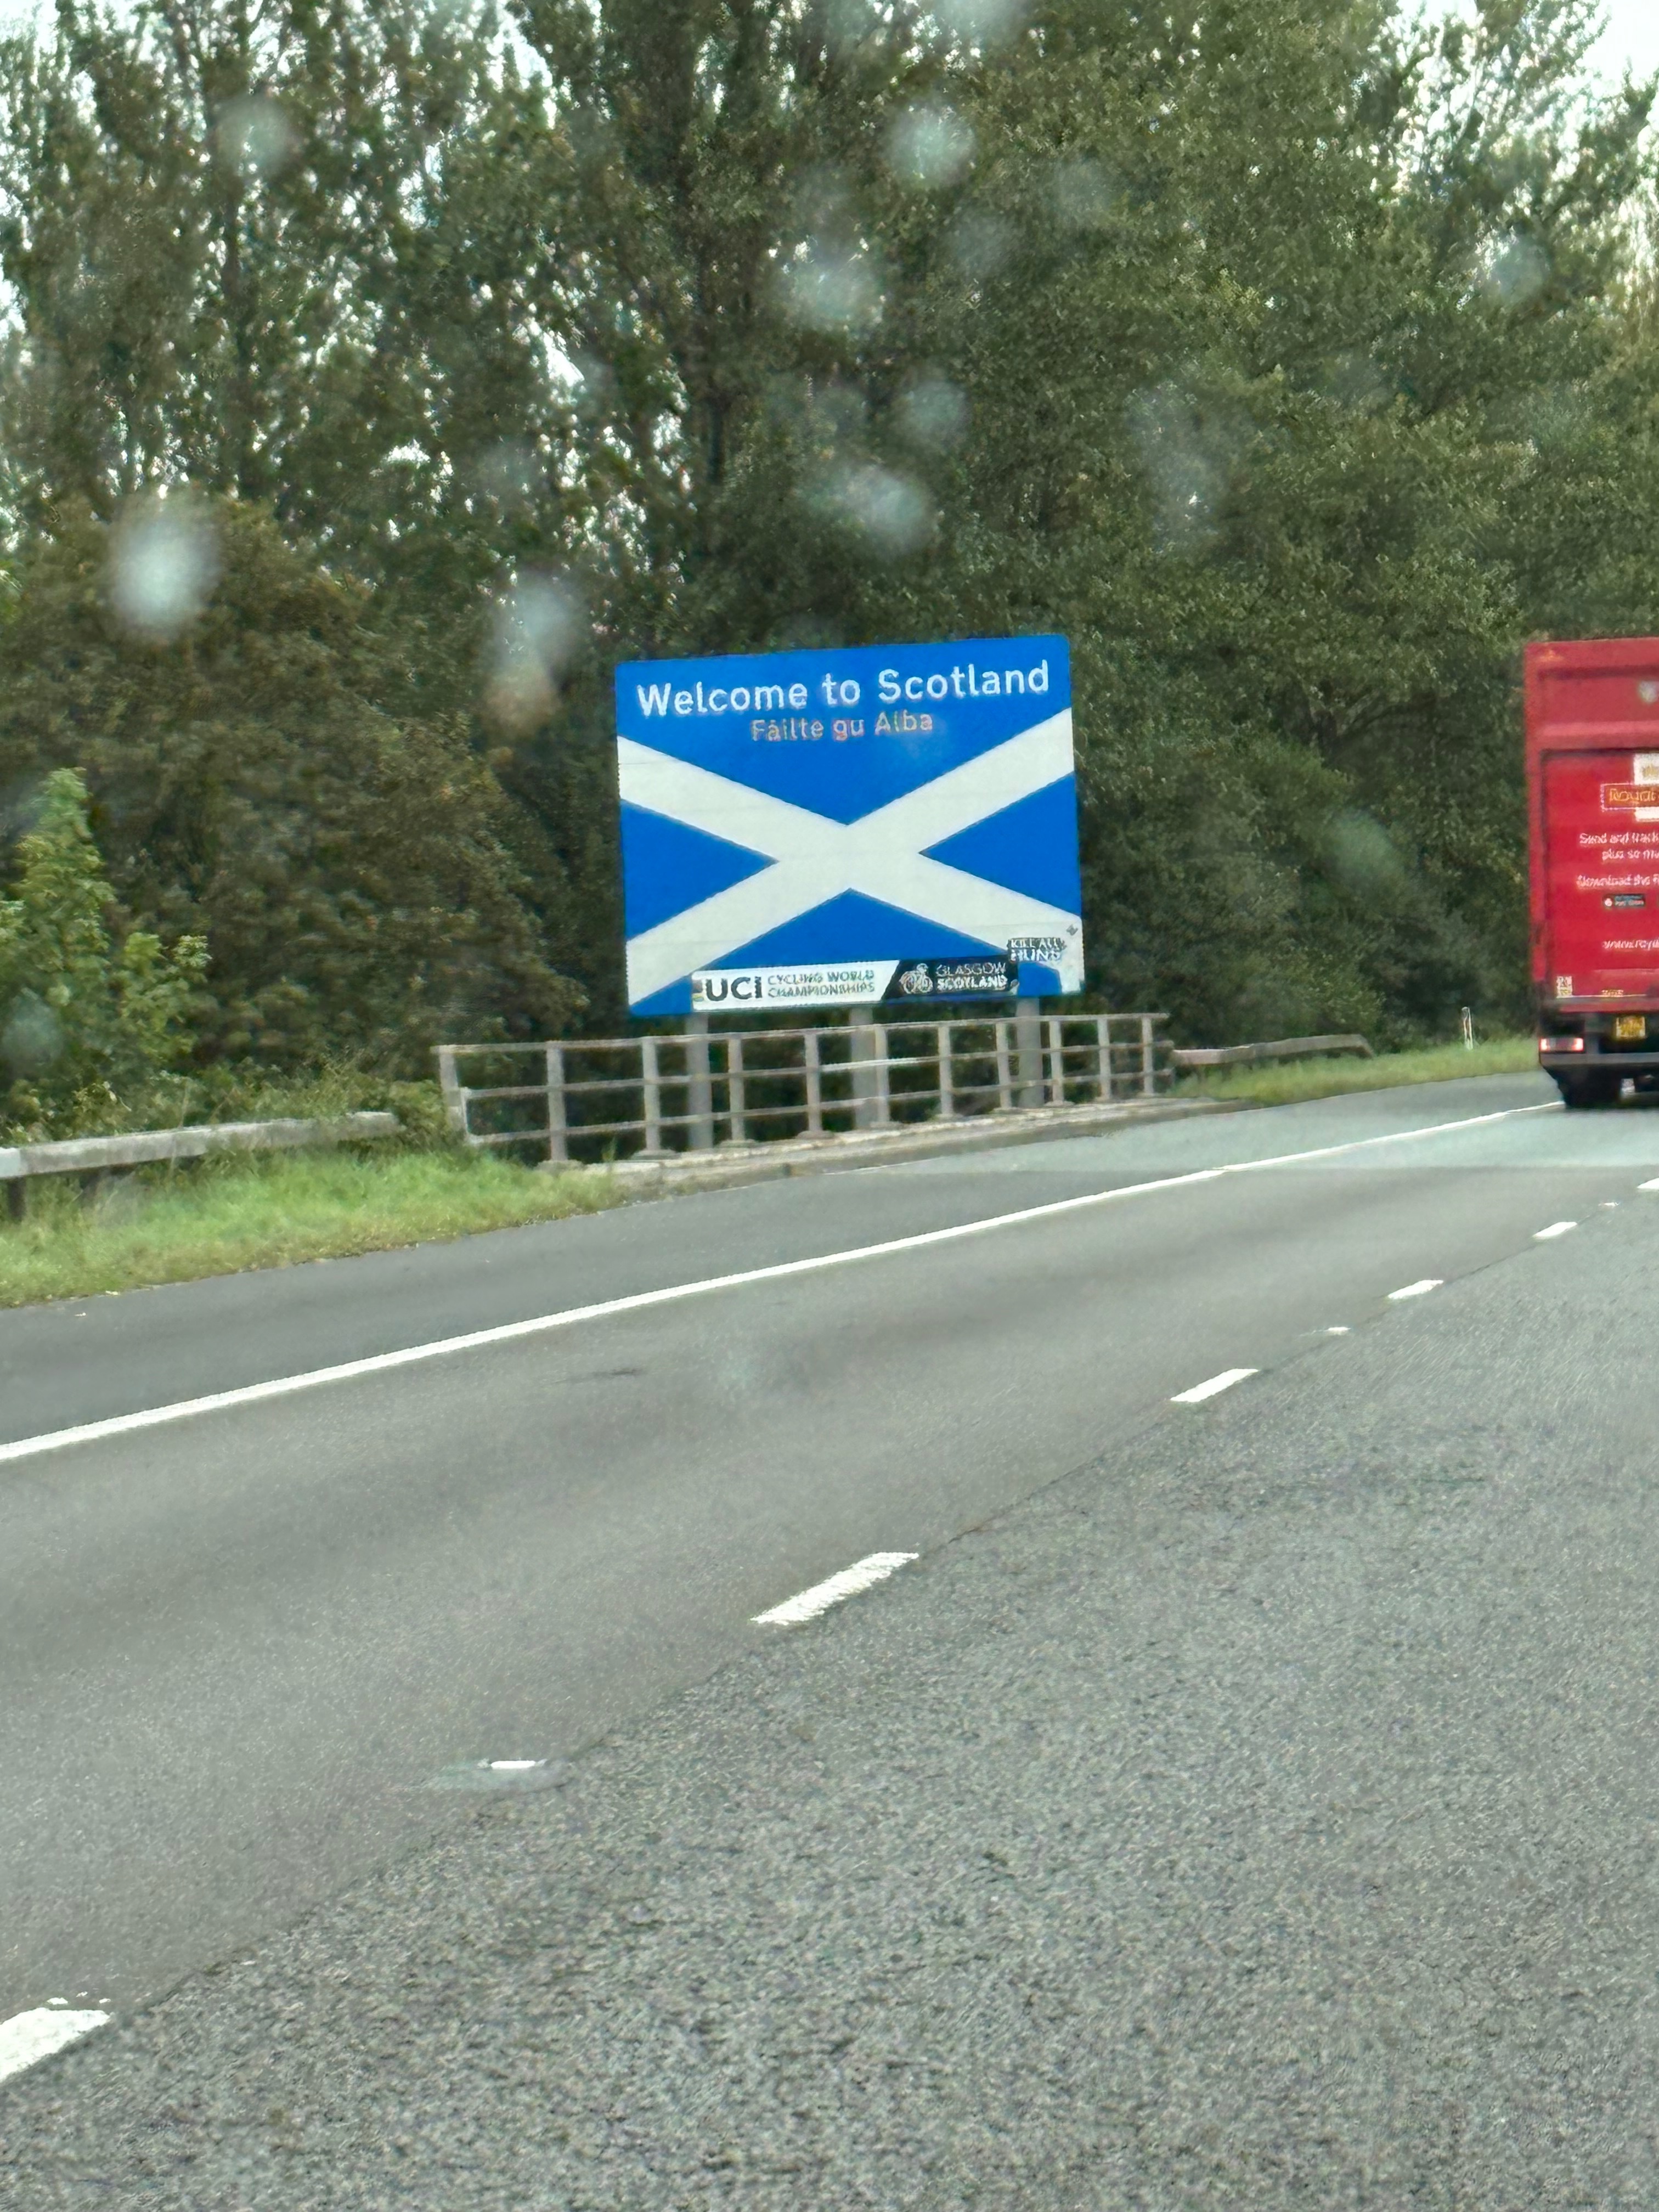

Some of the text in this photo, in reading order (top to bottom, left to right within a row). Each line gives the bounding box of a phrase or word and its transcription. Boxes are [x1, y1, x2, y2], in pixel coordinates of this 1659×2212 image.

[637, 659, 1048, 716] Welcome to Scotland
[833, 719, 864, 741] gu
[875, 710, 933, 735] Alba
[768, 970, 875, 985] CYCLING WORLD
[936, 962, 1007, 977] GLASGOW
[706, 976, 763, 1002] UCI
[768, 982, 876, 998] CHAMPIONSHIPS
[936, 975, 1008, 990] SCOTLAND
